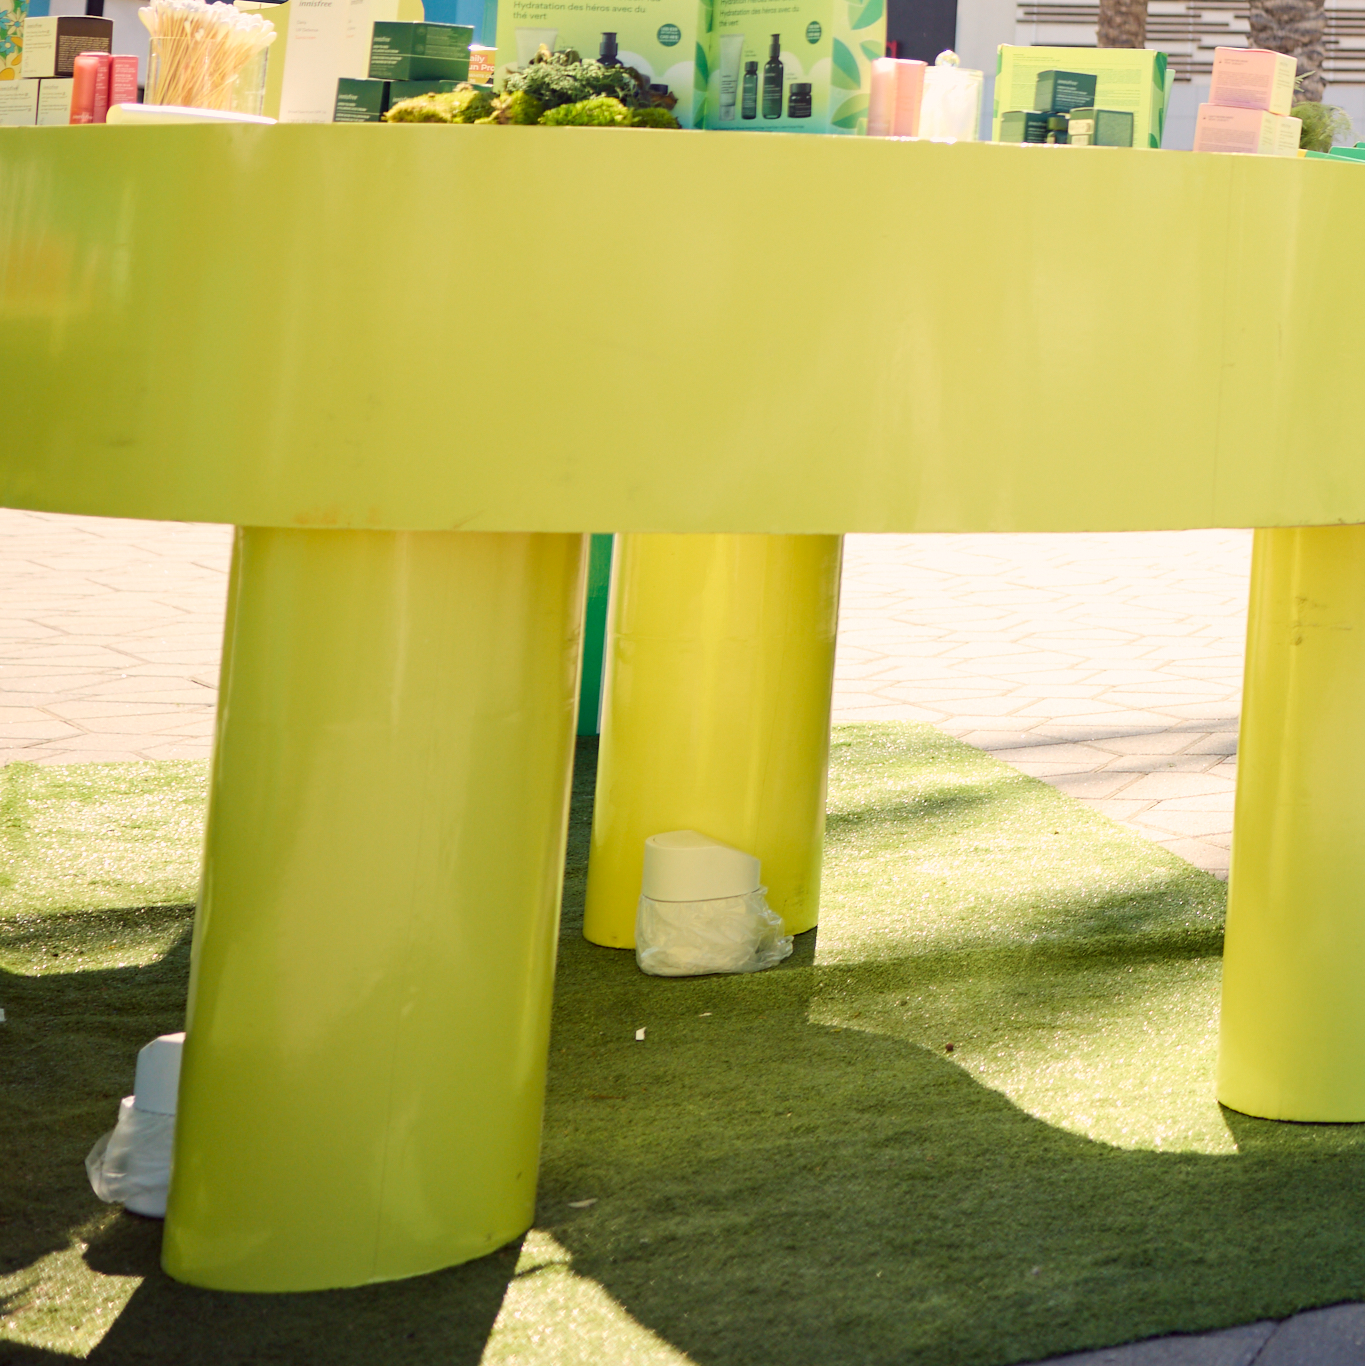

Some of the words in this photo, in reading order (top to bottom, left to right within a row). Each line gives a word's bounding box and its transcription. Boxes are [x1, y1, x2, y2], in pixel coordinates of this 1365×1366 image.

[299, 0, 333, 8] innisfree
[513, 1, 565, 11] Hydratation
[568, 3, 583, 11] des
[586, 3, 610, 12] héros
[634, 4, 646, 13] du
[470, 54, 485, 64] aily
